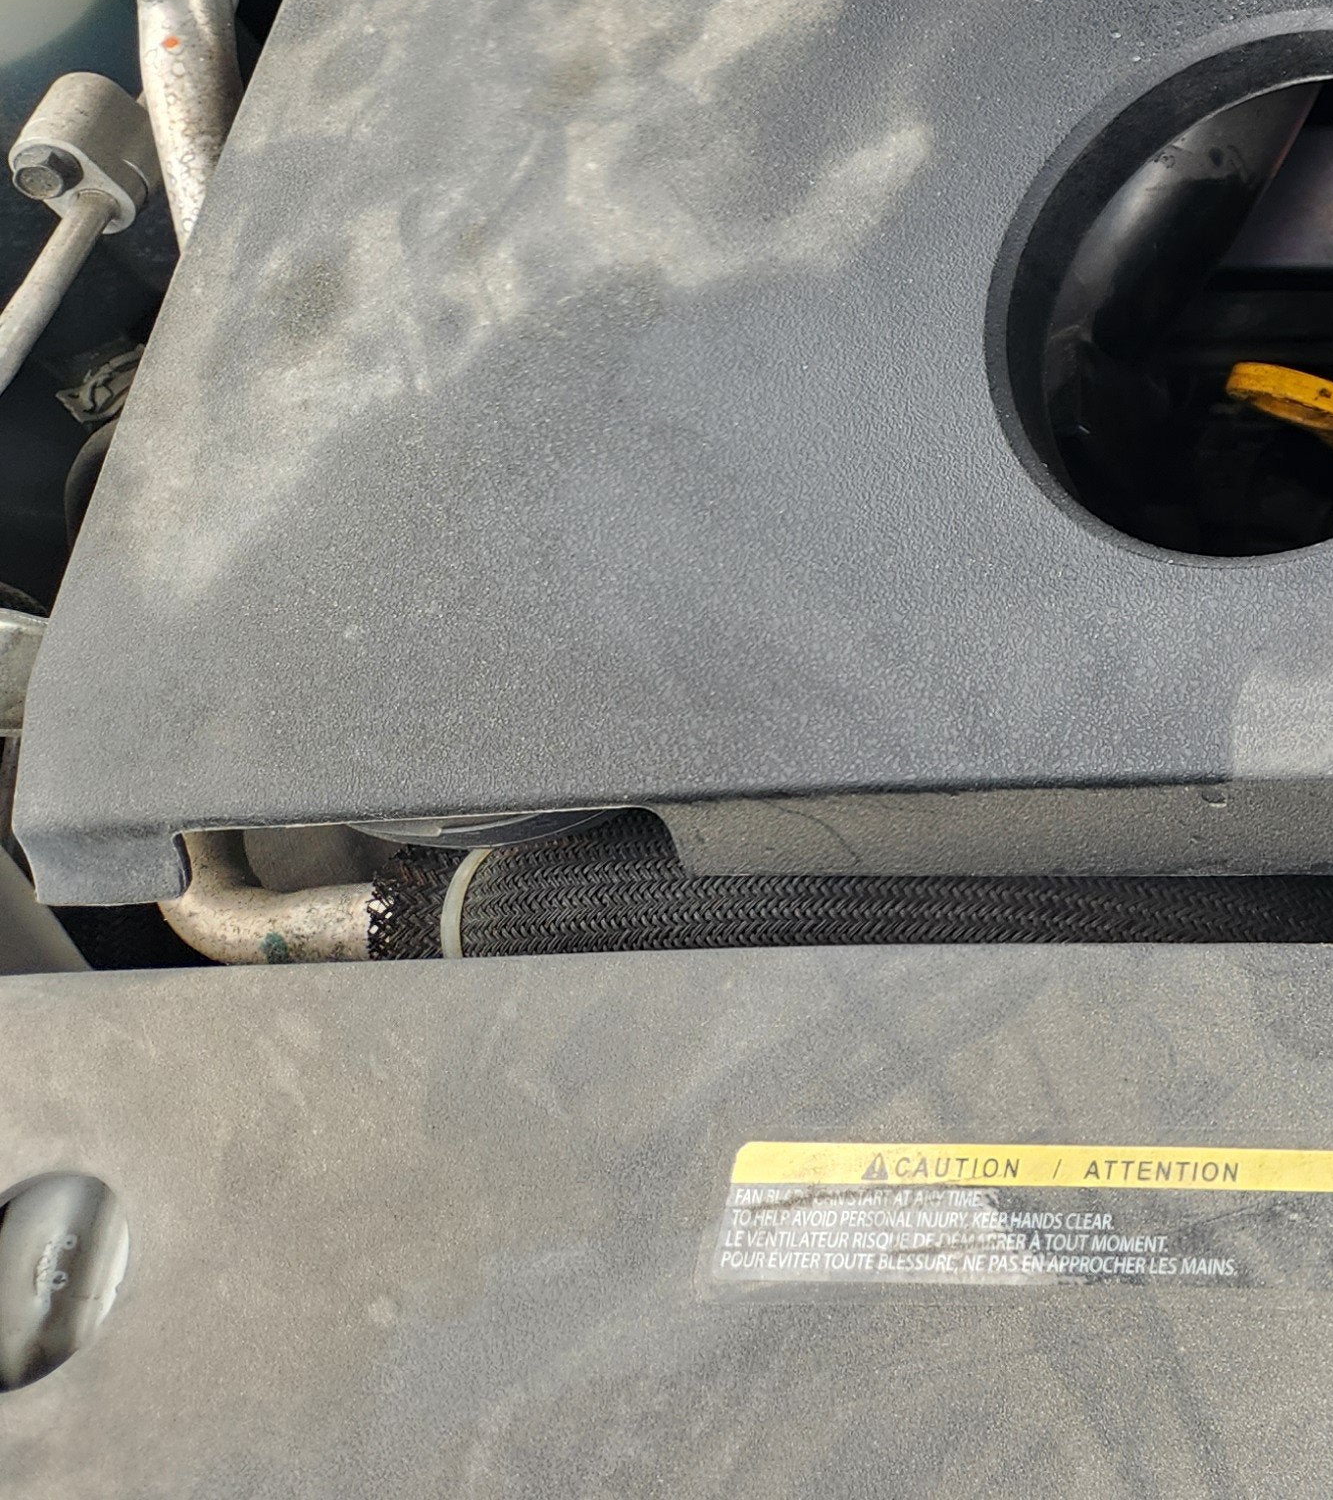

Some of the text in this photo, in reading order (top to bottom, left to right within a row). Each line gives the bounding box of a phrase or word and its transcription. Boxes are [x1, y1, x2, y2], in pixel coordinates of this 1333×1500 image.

[894, 1156, 1020, 1179] CAUTION
[1084, 1159, 1240, 1182] ATTENTION
[734, 1188, 763, 1204] FAN
[892, 1190, 913, 1206] AT
[733, 1208, 751, 1226] TO
[753, 1209, 790, 1227] HELP
[792, 1209, 838, 1227] AVOID
[840, 1210, 913, 1228] PERSONAL
[972, 1211, 1008, 1229] KEEP
[1010, 1212, 1063, 1230] HANDS
[1065, 1212, 1115, 1231] CLEAR.
[724, 1229, 745, 1247] LE
[747, 1230, 849, 1249] VENTILATEUR
[852, 1231, 910, 1250] RISQUE
[1044, 1233, 1089, 1252] TOUT
[1090, 1234, 1169, 1253] MOMENT.
[720, 1250, 765, 1268] POUR
[823, 1252, 876, 1270] TOUTE
[961, 1254, 986, 1272] NE
[987, 1254, 1019, 1273] PAS
[1020, 1254, 1045, 1274] EN
[1046, 1255, 1146, 1276] APPROCHER
[1149, 1257, 1178, 1275] LES
[1179, 1258, 1239, 1277] MAINS.
